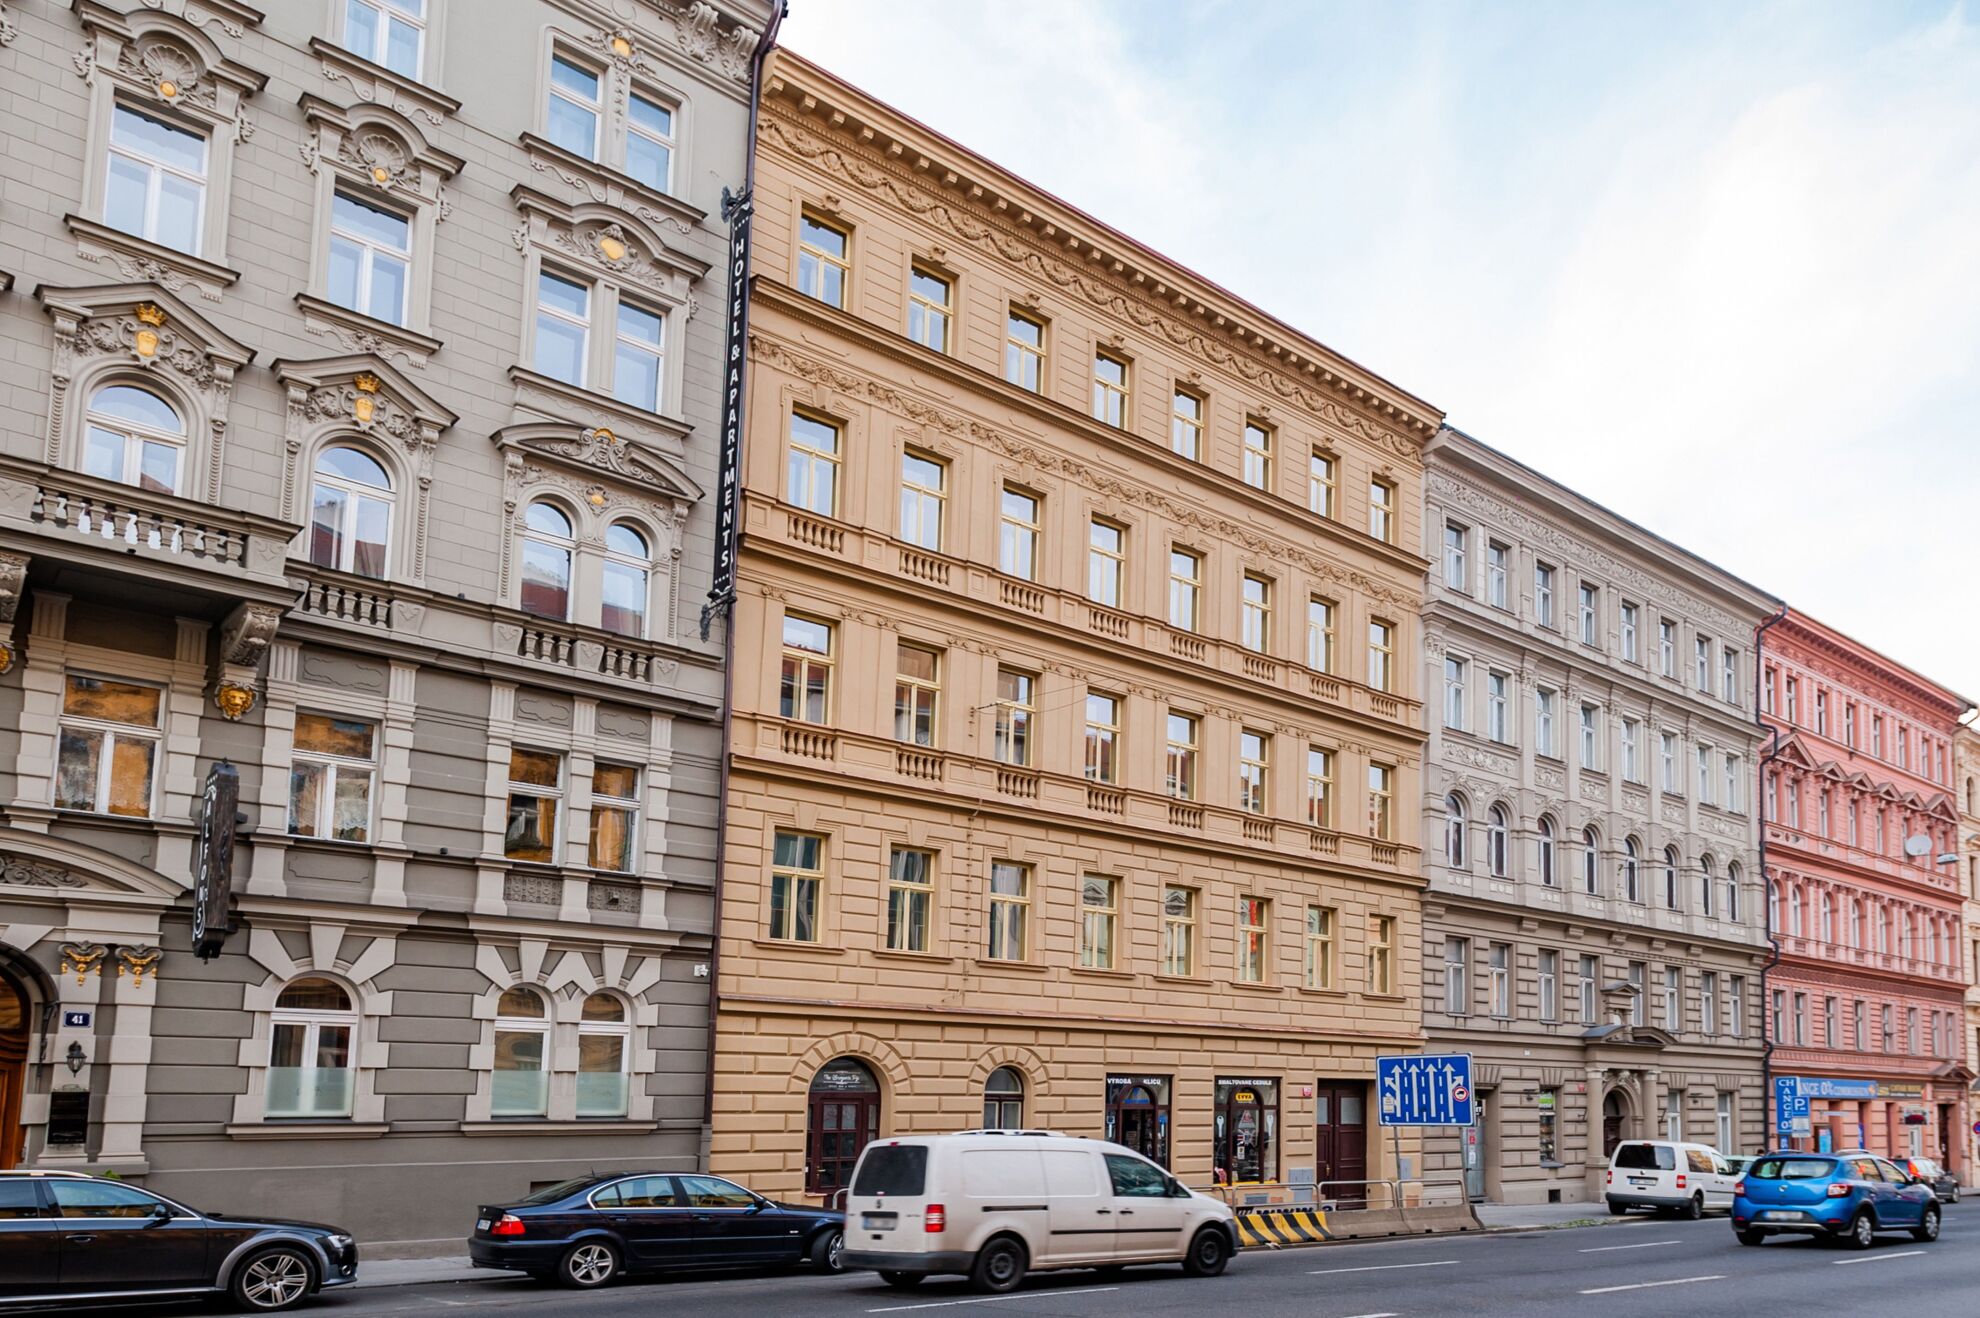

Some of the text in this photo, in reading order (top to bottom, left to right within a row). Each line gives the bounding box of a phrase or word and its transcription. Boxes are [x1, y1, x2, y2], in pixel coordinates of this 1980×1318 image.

[721, 238, 745, 568] HOTEL & APARTMENTS
[196, 800, 212, 923] ALFONS
[72, 1015, 84, 1024] 41
[1794, 1098, 1806, 1111] P
